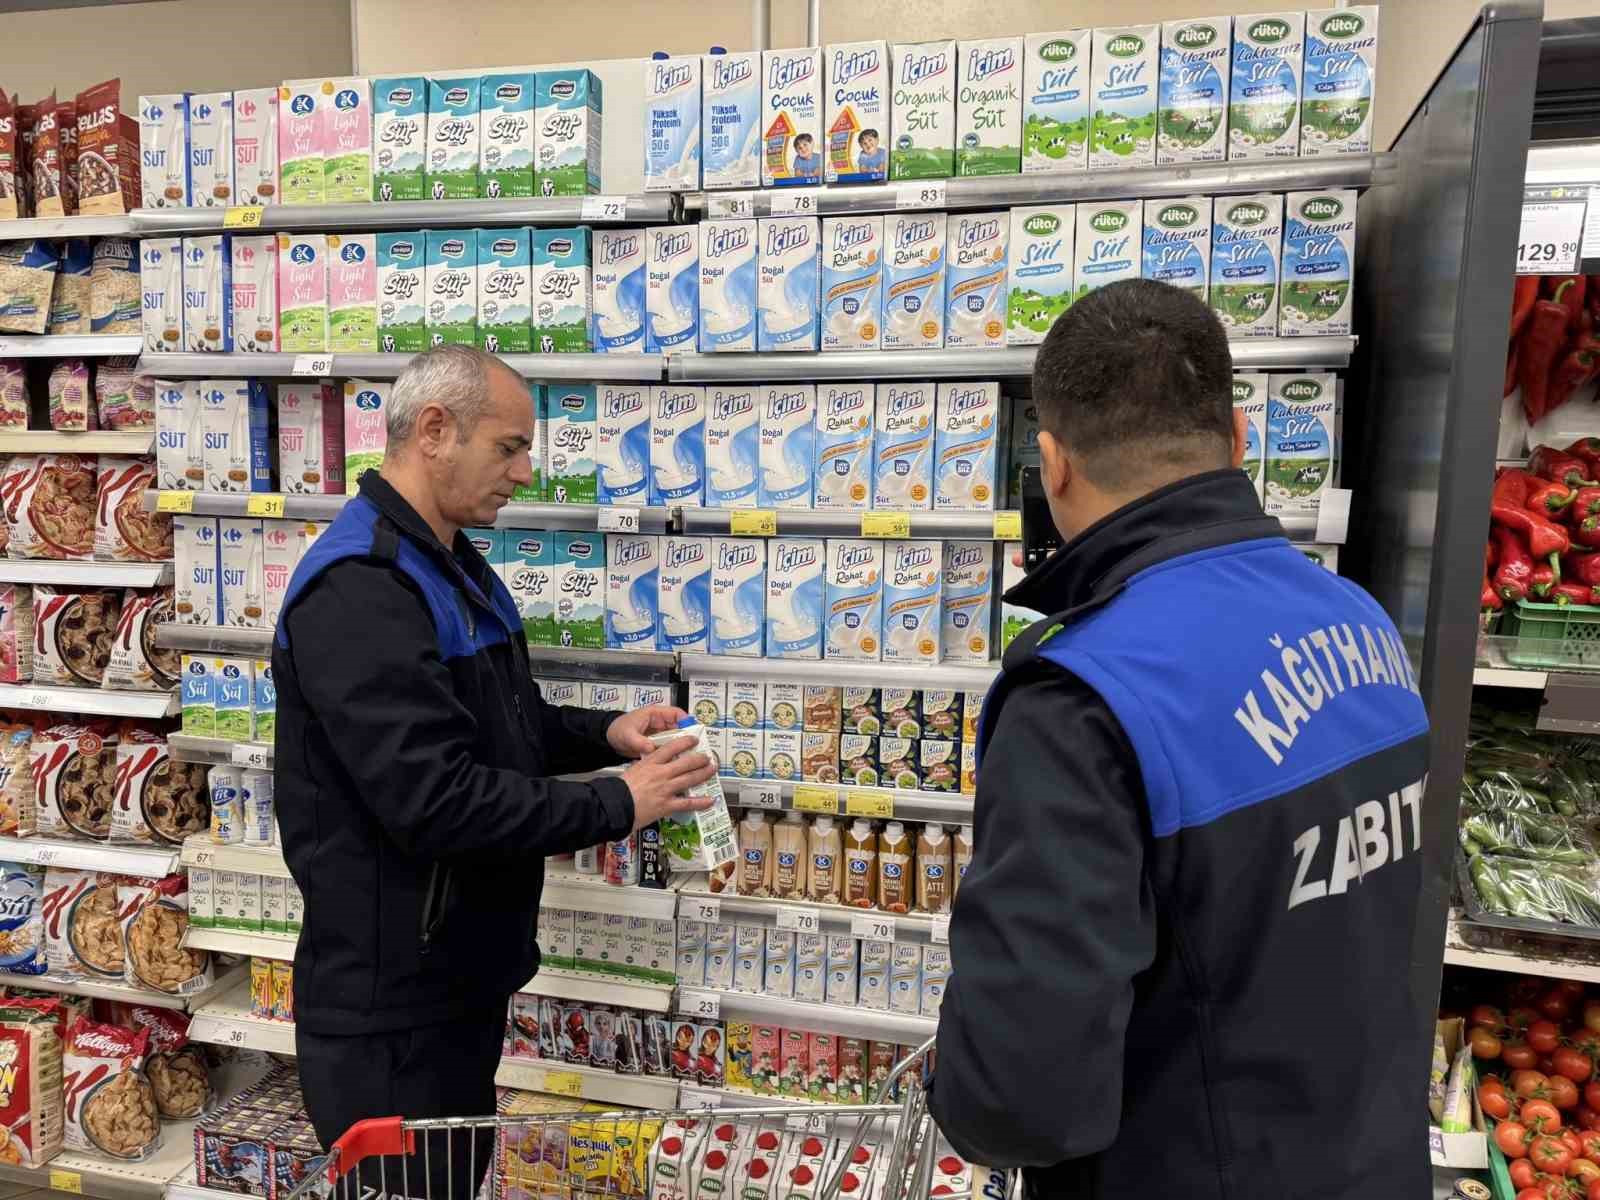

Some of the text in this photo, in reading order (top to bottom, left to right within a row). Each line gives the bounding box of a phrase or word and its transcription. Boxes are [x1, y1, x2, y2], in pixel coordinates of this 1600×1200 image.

[1252, 23, 1287, 40] sütaş
[1325, 16, 1360, 34] sütaş
[1110, 37, 1142, 53] sütaş
[1178, 28, 1212, 45] sütaş
[1042, 43, 1074, 58] sütaş
[1166, 47, 1227, 66] Laktozsuz
[1237, 43, 1301, 63] Laktozsuz
[1310, 37, 1375, 57] Laktozsuz
[713, 59, 752, 89] İçim
[769, 56, 814, 90] İçim
[833, 49, 879, 85] İçim
[902, 53, 947, 84] İçim
[967, 48, 1014, 82] İçim
[1104, 61, 1146, 88] Süt
[1248, 60, 1287, 82] Süt
[1321, 54, 1360, 78] Süt
[655, 65, 691, 93] İçim
[1037, 66, 1078, 92] Süt
[1176, 64, 1212, 88] Süt
[771, 93, 815, 111] Çocuk
[835, 86, 880, 105] Çocuk
[894, 85, 951, 108] Organik
[960, 83, 1019, 106] Organik
[490, 115, 528, 142] Süt
[542, 111, 582, 140] Süt
[906, 109, 939, 131] Süt
[972, 107, 1006, 130] Süt
[381, 119, 418, 145] Süt
[436, 118, 474, 145] Süt
[794, 197, 810, 209] 78
[921, 190, 938, 201] 83
[603, 204, 618, 215] 72
[730, 201, 745, 213] 81
[1162, 208, 1193, 225] sütaş
[1231, 206, 1264, 223] sütaş
[1303, 201, 1338, 217] sütaş
[242, 213, 256, 223] 69
[1027, 217, 1057, 232] sütaş
[1092, 213, 1125, 229] sütaş
[767, 224, 809, 256] İçim
[833, 222, 873, 252] İçim
[895, 219, 936, 250] İçim
[958, 219, 999, 249] İçim
[1147, 228, 1209, 245] Laktozsuz
[1216, 223, 1280, 244] Laktozsuz
[1289, 220, 1353, 240] Laktozsuz
[600, 233, 639, 265] İçim
[654, 231, 692, 263] İçim
[707, 226, 749, 258] İçim
[1088, 236, 1130, 263] Süt
[1227, 240, 1263, 264] Süt
[1300, 237, 1337, 259] Süt
[833, 250, 862, 268] Rahat
[894, 249, 924, 266] Rahat
[957, 248, 988, 265] Rahat
[1021, 240, 1062, 266] Süt
[1157, 243, 1191, 266] Süt
[596, 274, 616, 283] Doğal
[650, 271, 669, 281] Doğal
[702, 267, 724, 277] Doğal
[762, 266, 784, 276] Doğal
[384, 272, 418, 298] Süt
[434, 271, 470, 297] Süt
[486, 271, 523, 297] Süt
[541, 271, 579, 297] Süt
[312, 361, 325, 371] 60
[1285, 384, 1318, 398] sütaş
[605, 390, 643, 419] İçim
[658, 390, 697, 420] İçim
[713, 391, 753, 420] İçim
[767, 390, 806, 419] İçim
[827, 389, 864, 416] İçim
[887, 389, 925, 416] İçim
[948, 388, 987, 416] İçim
[1271, 402, 1333, 419] Laktozsuz
[600, 427, 620, 436] Doğal
[653, 427, 674, 437] Doğal
[709, 429, 729, 438] Doğal
[762, 428, 783, 438] Doğal
[827, 416, 854, 431] Rahat
[885, 416, 914, 431] Rahat
[946, 416, 976, 431] Rahat
[1282, 416, 1318, 438] Süt
[554, 425, 592, 451] Süt
[265, 502, 277, 512] 31
[618, 516, 633, 527] 70
[615, 539, 651, 567] İçim
[666, 541, 704, 568] İçim
[719, 543, 757, 570] İçim
[777, 544, 816, 572] İçim
[837, 543, 876, 570] İçim
[895, 544, 934, 571] İçim
[511, 571, 549, 596] Süt
[561, 570, 599, 596] Süt
[611, 575, 630, 584] Doğal
[661, 575, 682, 585] Doğal
[714, 578, 734, 588] Doğal
[771, 580, 792, 590] Doğal
[836, 571, 863, 585] Rahat
[894, 571, 922, 585] Rahat
[187, 680, 208, 699] Süt
[221, 683, 243, 703] Süt
[249, 754, 262, 763] 45
[760, 793, 774, 804] 28
[217, 823, 229, 833] 26
[1288, 771, 1429, 911] ZABIT
[196, 853, 208, 863] 67
[927, 881, 944, 892] ATTE
[699, 907, 713, 918] 75
[799, 916, 813, 927] 70
[873, 925, 888, 936] 70
[700, 1001, 713, 1013] 23
[74, 1031, 135, 1057] Kellogg's
[230, 1031, 242, 1042] 36
